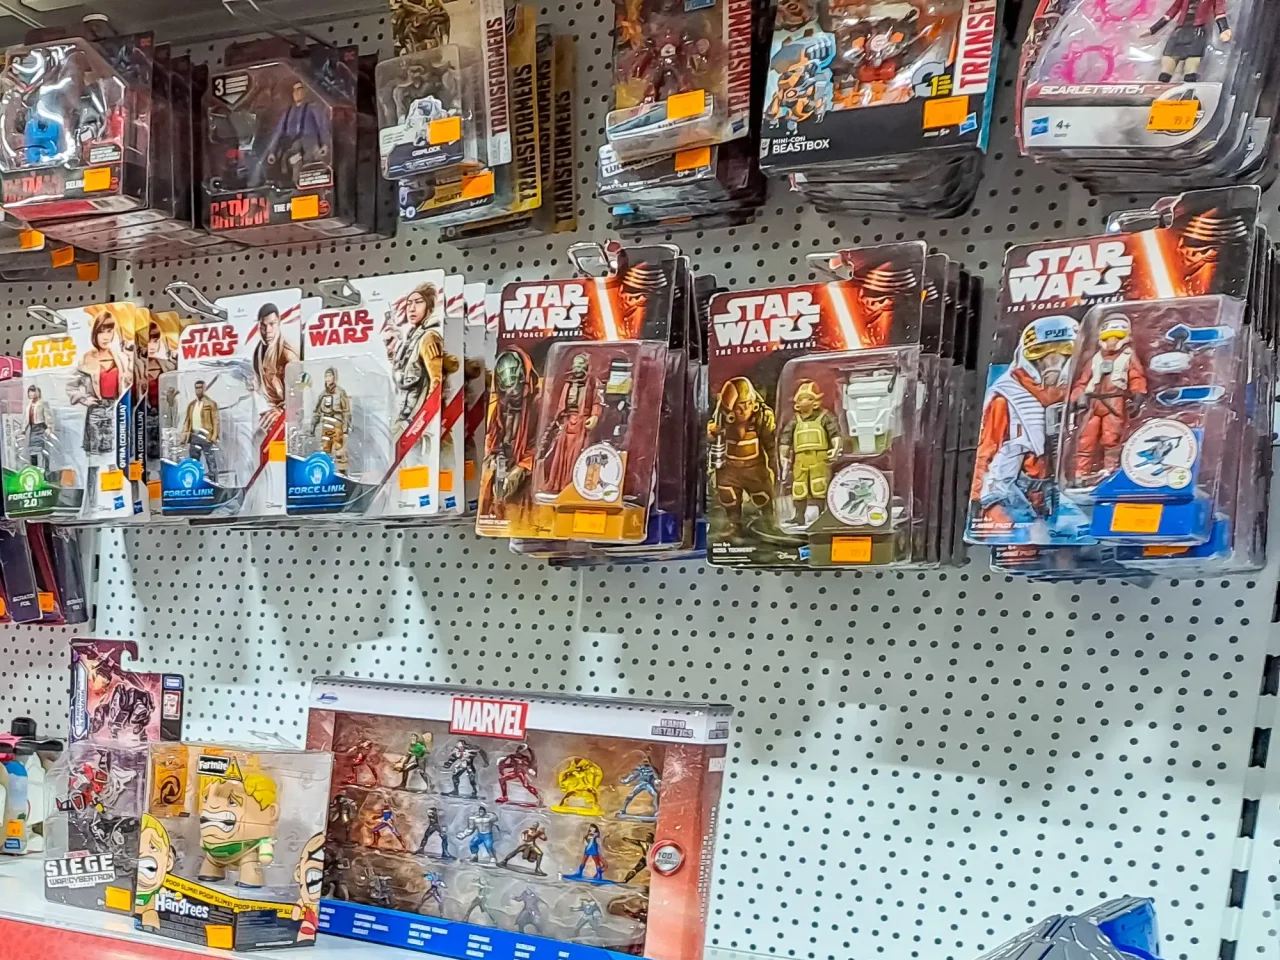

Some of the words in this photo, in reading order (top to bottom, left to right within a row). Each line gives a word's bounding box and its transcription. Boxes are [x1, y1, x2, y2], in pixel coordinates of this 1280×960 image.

[959, 0, 996, 89] TRANSF
[486, 16, 508, 137] TRANSFORMERS
[1039, 85, 1098, 96] SCARLET
[516, 63, 538, 203] TRANSFORMERS
[772, 135, 806, 145] MINI-CON
[772, 138, 830, 154] BEASTBOX
[1009, 241, 1133, 278] STAR
[1009, 266, 1133, 303] WARS
[504, 284, 589, 309] STAR
[714, 291, 820, 323] STAR
[309, 309, 374, 331] STAR
[503, 306, 588, 331] WARS
[1007, 305, 1025, 314] THE
[181, 324, 239, 344] STAR
[309, 325, 374, 347] WARS
[714, 314, 820, 347] WARS
[25, 336, 77, 356] STAR
[181, 339, 239, 360] WARS
[25, 350, 76, 371] WARS
[8, 491, 36, 500] FORCE
[37, 489, 53, 498] LINK
[163, 489, 191, 497] FORCE
[193, 488, 214, 496] LINK
[288, 486, 321, 494] FORCE
[322, 484, 345, 492] LINK
[451, 700, 525, 737] MARVEL
[45, 854, 114, 877] SIEGE
[154, 893, 209, 918] Hangrees
